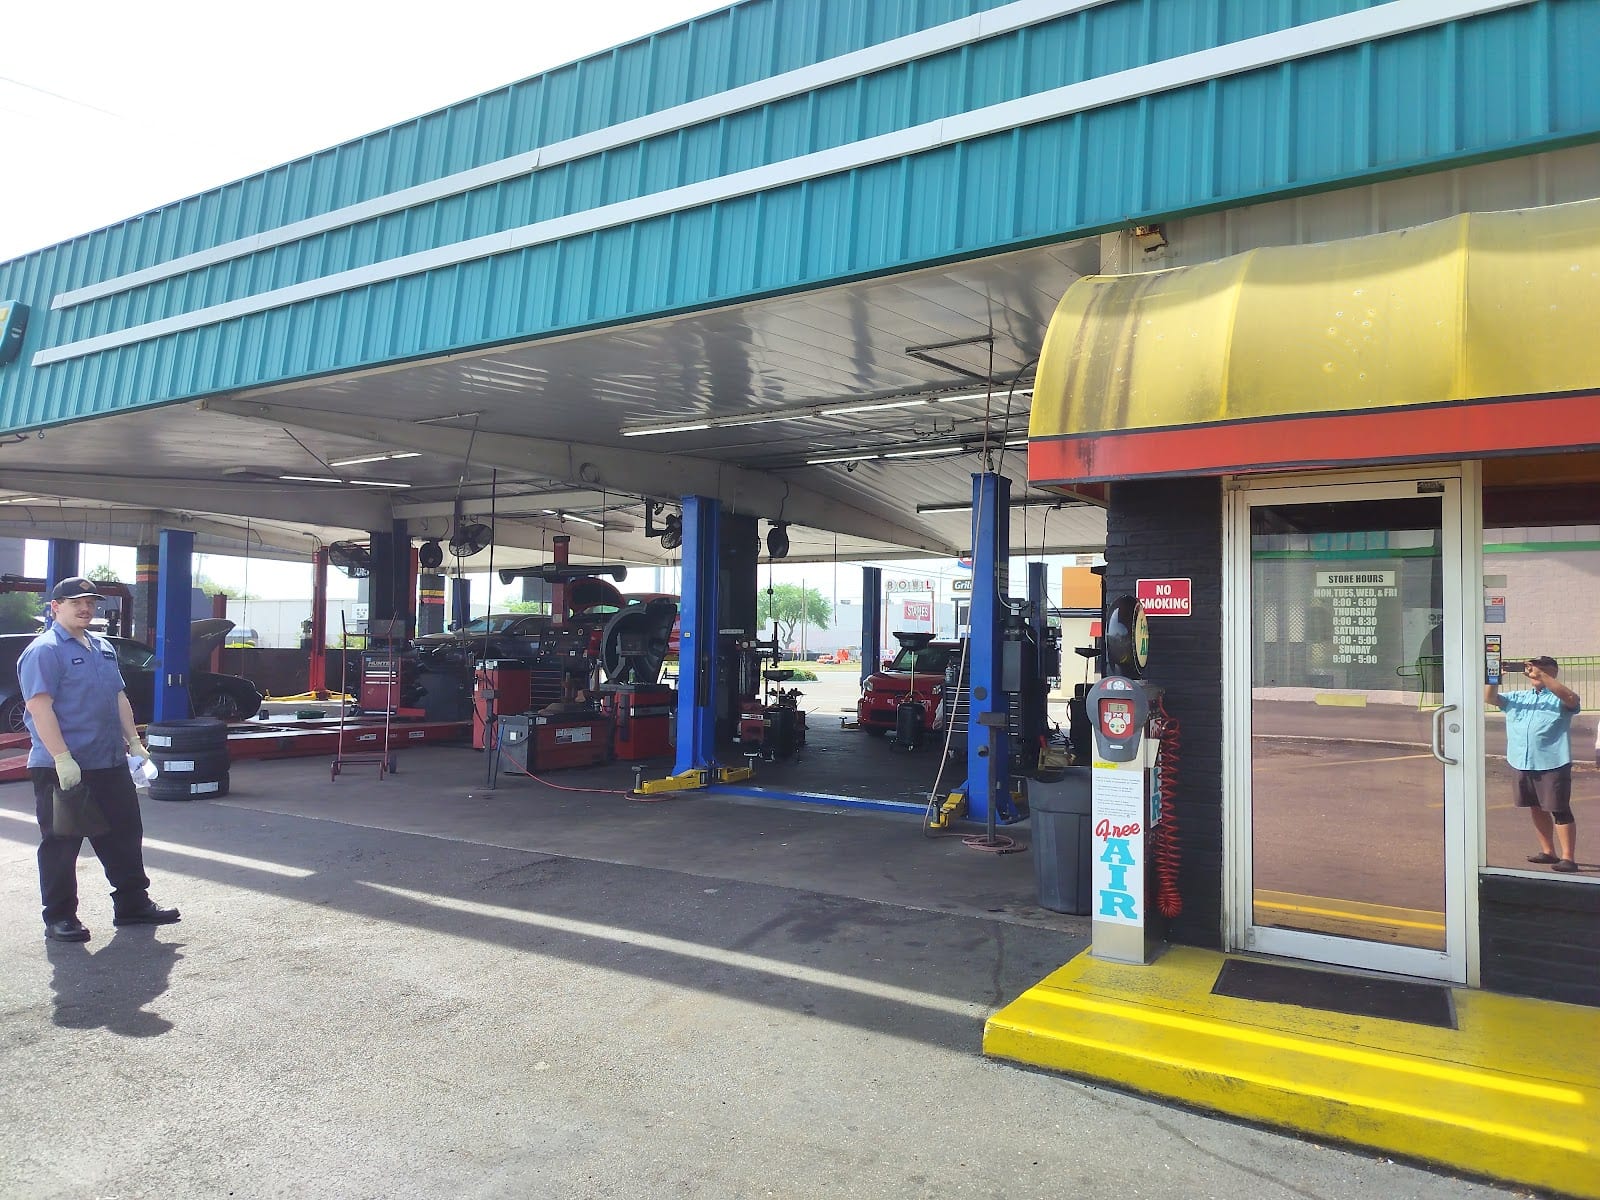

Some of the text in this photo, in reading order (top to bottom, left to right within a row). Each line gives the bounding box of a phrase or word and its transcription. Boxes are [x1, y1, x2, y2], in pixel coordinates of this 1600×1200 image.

[1328, 574, 1384, 584] STORE HOURS
[1156, 584, 1172, 596] NO
[1384, 588, 1398, 597] FRI
[1140, 598, 1188, 609] SMOKING
[1358, 598, 1378, 606] 6:00
[1334, 608, 1376, 616] THURSDAY
[1332, 616, 1352, 626] 8:00
[1358, 616, 1378, 626] 8:30
[1334, 626, 1376, 635] SATURDAY
[1332, 636, 1352, 644] 8:00
[1358, 636, 1378, 644] 5:00
[1338, 645, 1371, 654] SUNDAY
[1358, 655, 1378, 664] 5:00
[1096, 818, 1140, 841] Free
[1100, 838, 1138, 920] AIR
